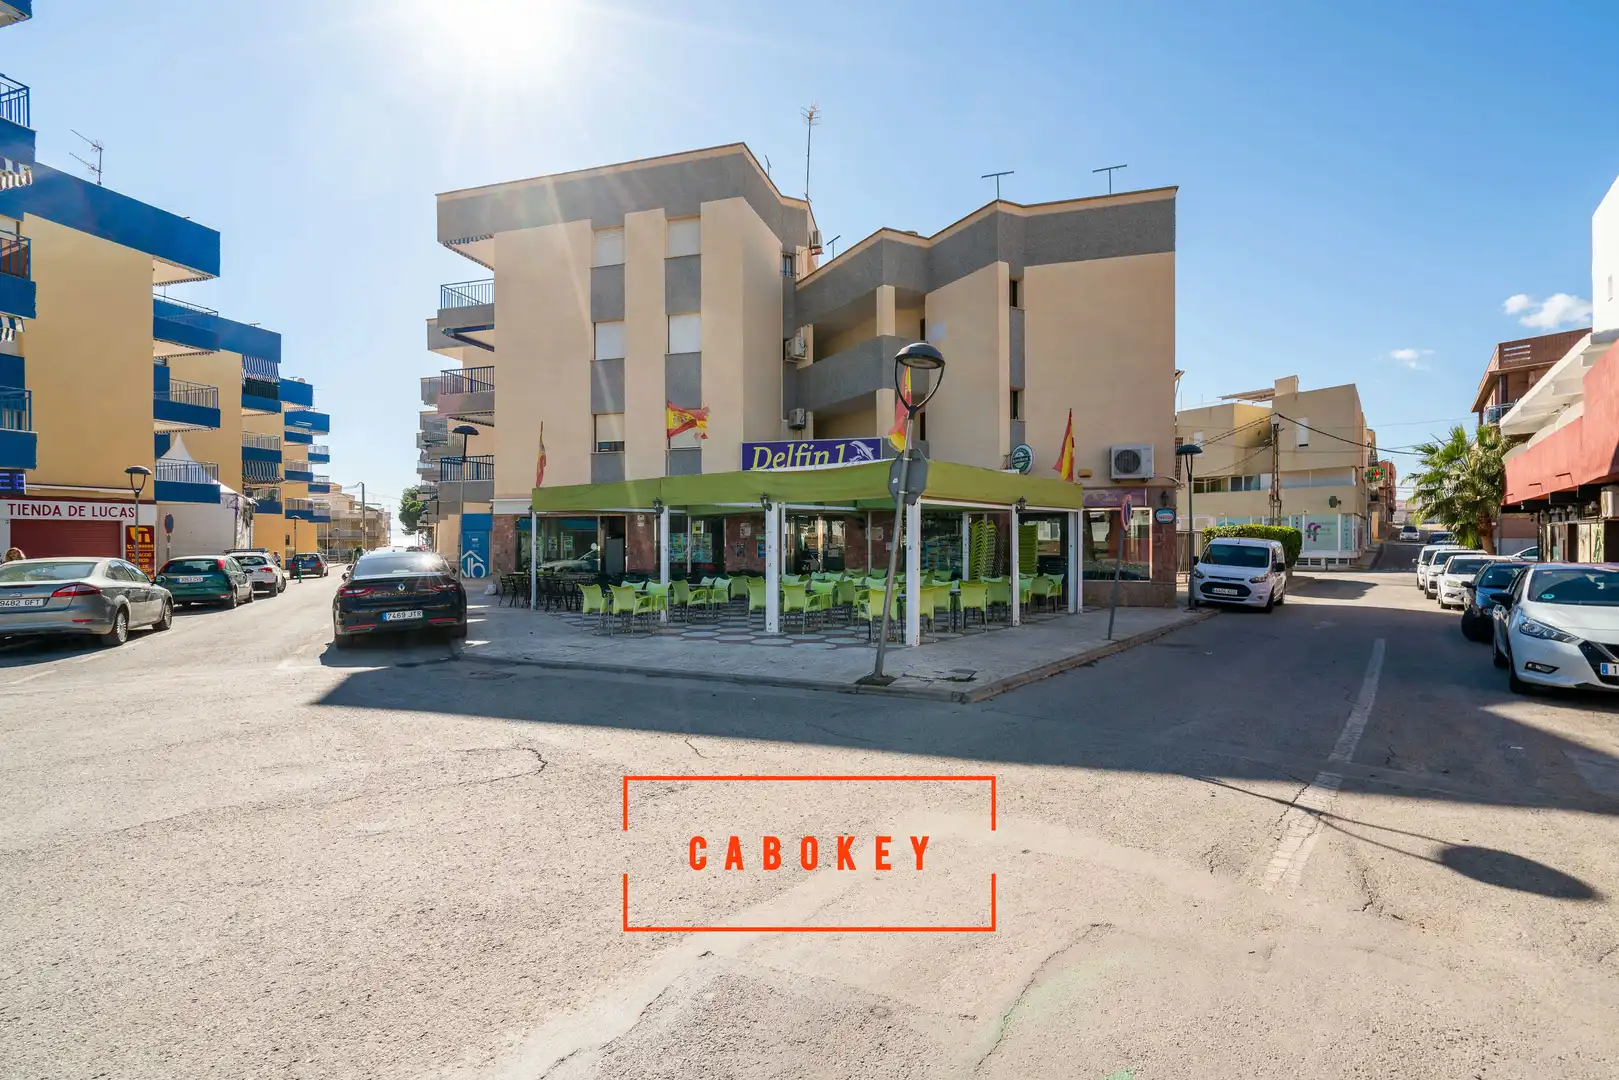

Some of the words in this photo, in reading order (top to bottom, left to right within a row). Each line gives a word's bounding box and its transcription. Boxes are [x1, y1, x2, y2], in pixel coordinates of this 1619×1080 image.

[835, 444, 846, 464] 1
[7, 503, 62, 516] TIENDA
[68, 505, 86, 517] DE
[91, 506, 135, 518] LUCAS
[0, 599, 21, 607] 9482
